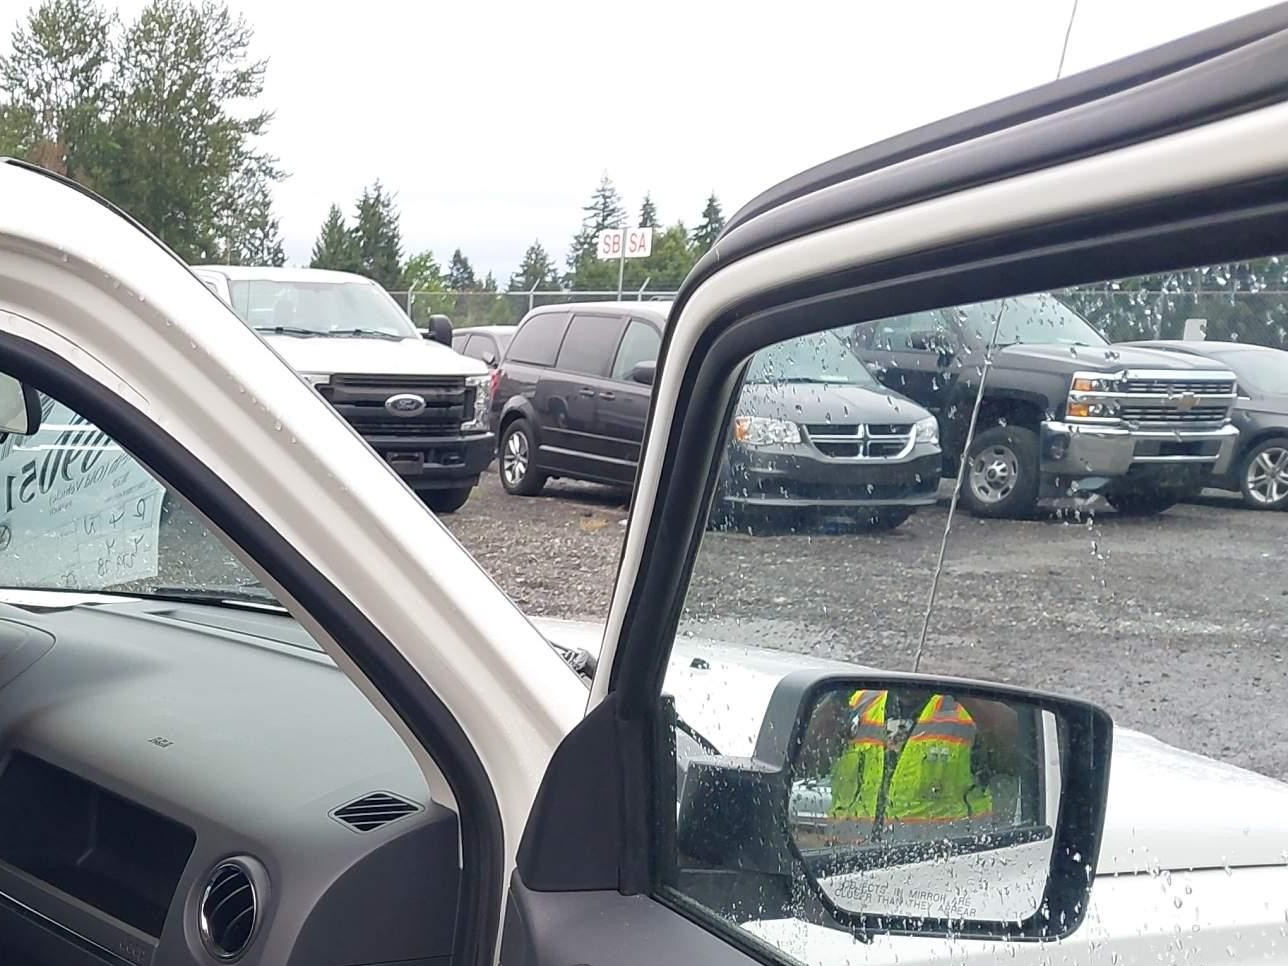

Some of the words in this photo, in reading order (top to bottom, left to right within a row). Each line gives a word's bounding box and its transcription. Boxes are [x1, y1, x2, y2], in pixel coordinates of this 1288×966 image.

[603, 234, 621, 254] SB
[629, 232, 647, 253] SA
[877, 895, 904, 904] THAN
[909, 899, 932, 912] THEY
[937, 904, 977, 917] APPEAR
[894, 888, 904, 897] IN
[909, 890, 947, 904] MIRROR
[951, 896, 971, 907] ARE
